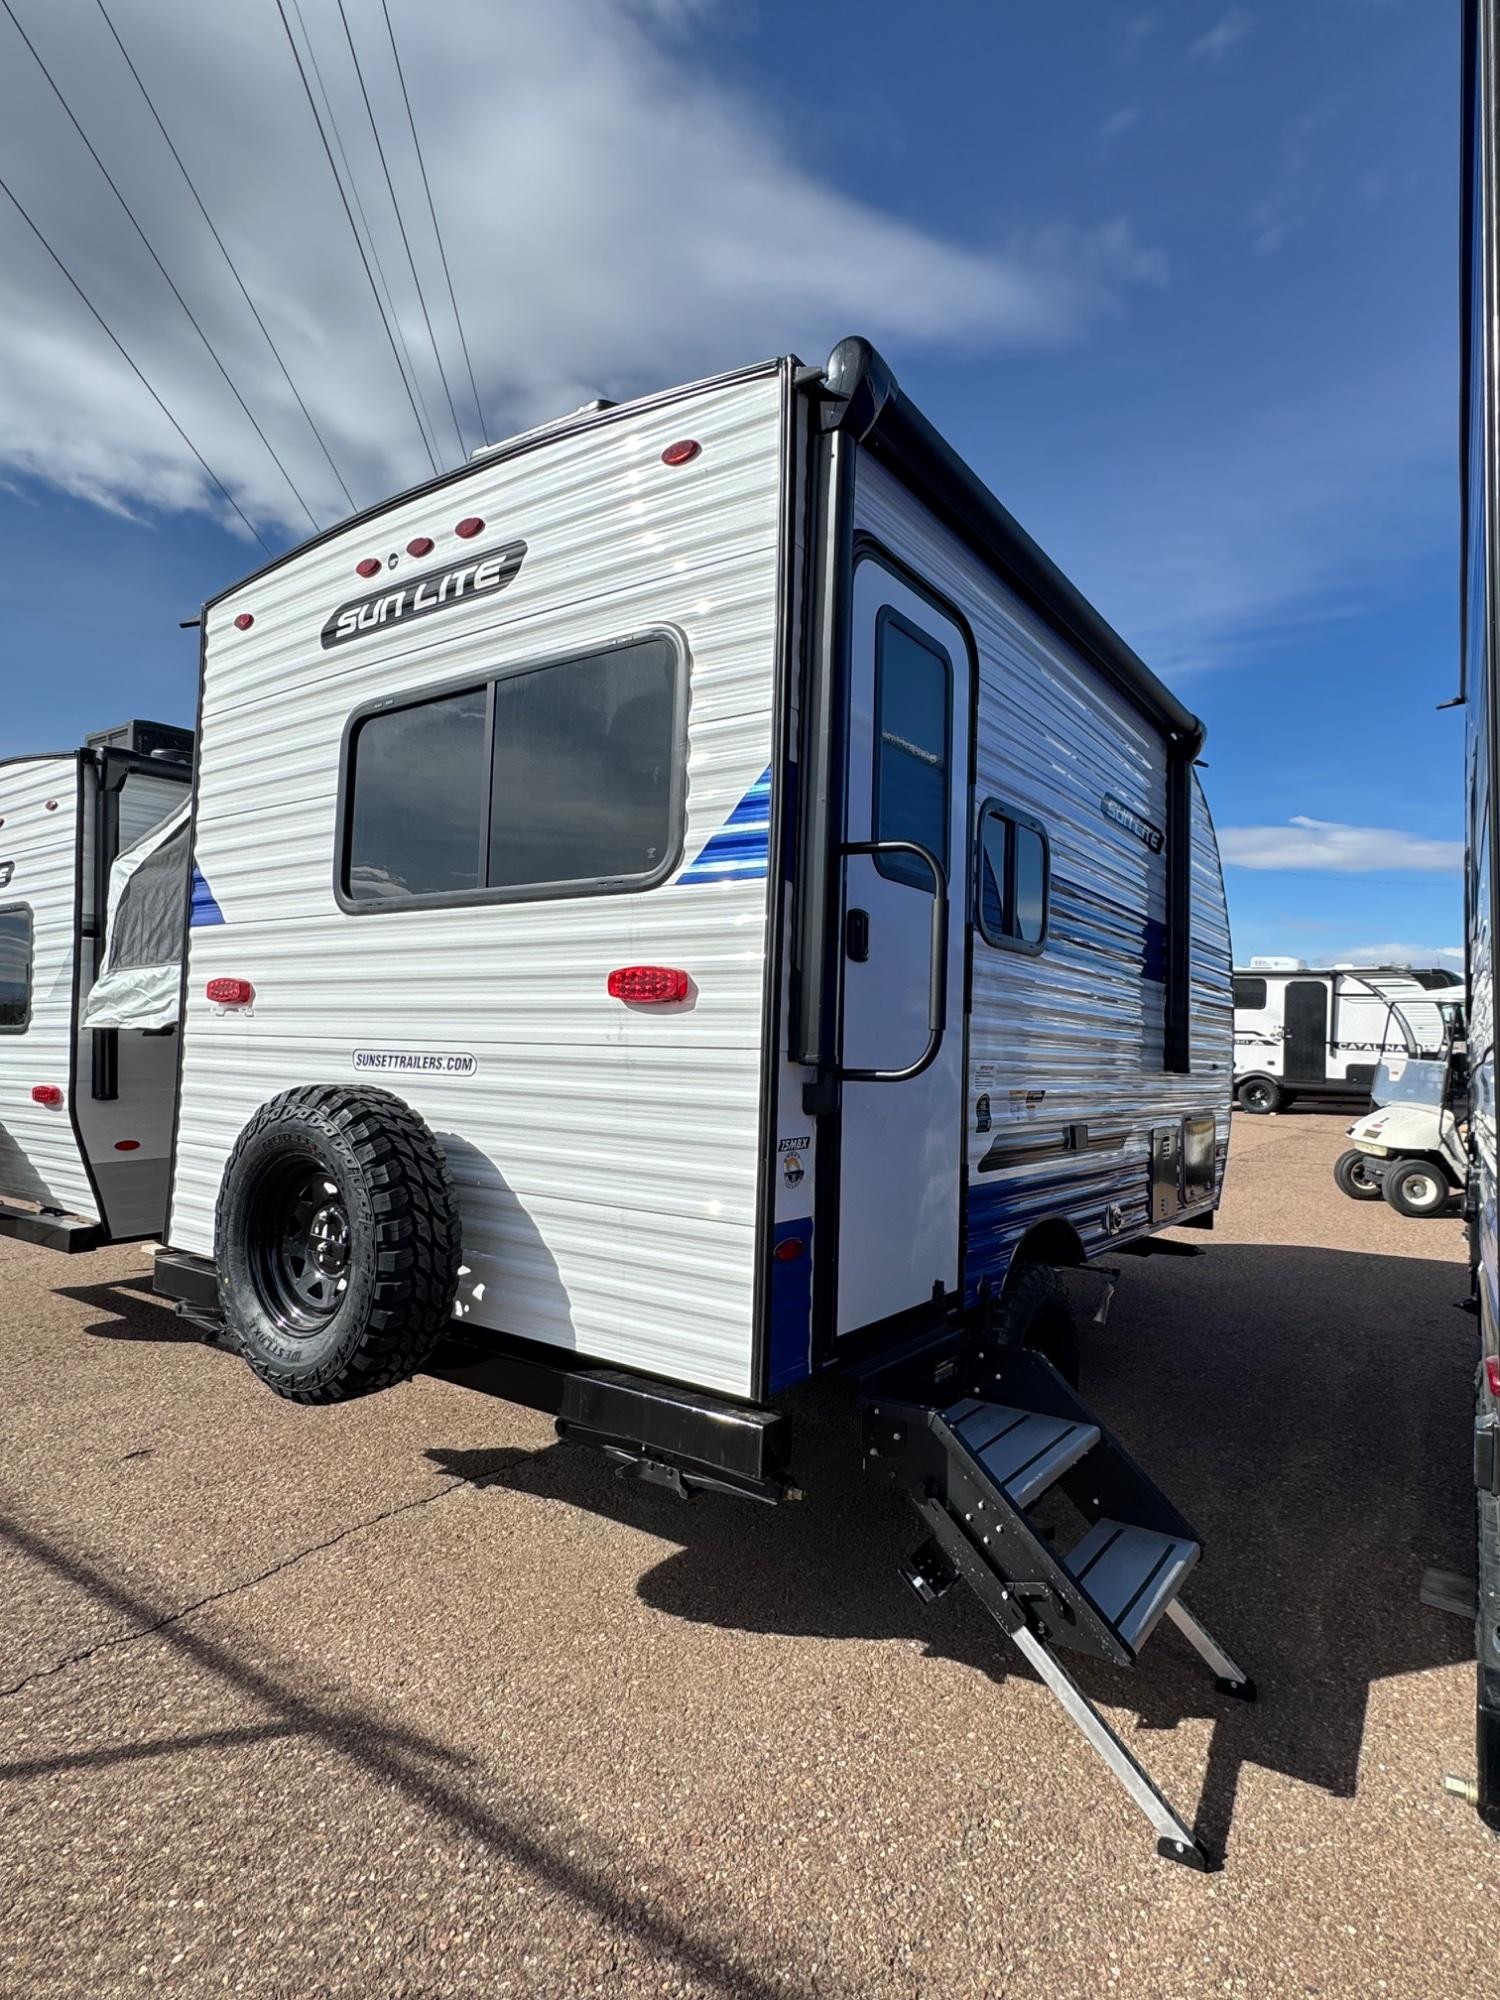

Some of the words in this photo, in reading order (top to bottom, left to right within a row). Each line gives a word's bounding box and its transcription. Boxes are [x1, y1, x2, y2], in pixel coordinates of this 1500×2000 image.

[335, 590, 407, 638] SUN
[413, 554, 507, 611] LITE
[1338, 1042, 1405, 1052] CATALNA
[355, 1053, 474, 1072] SUNSETTRAILERS.COM
